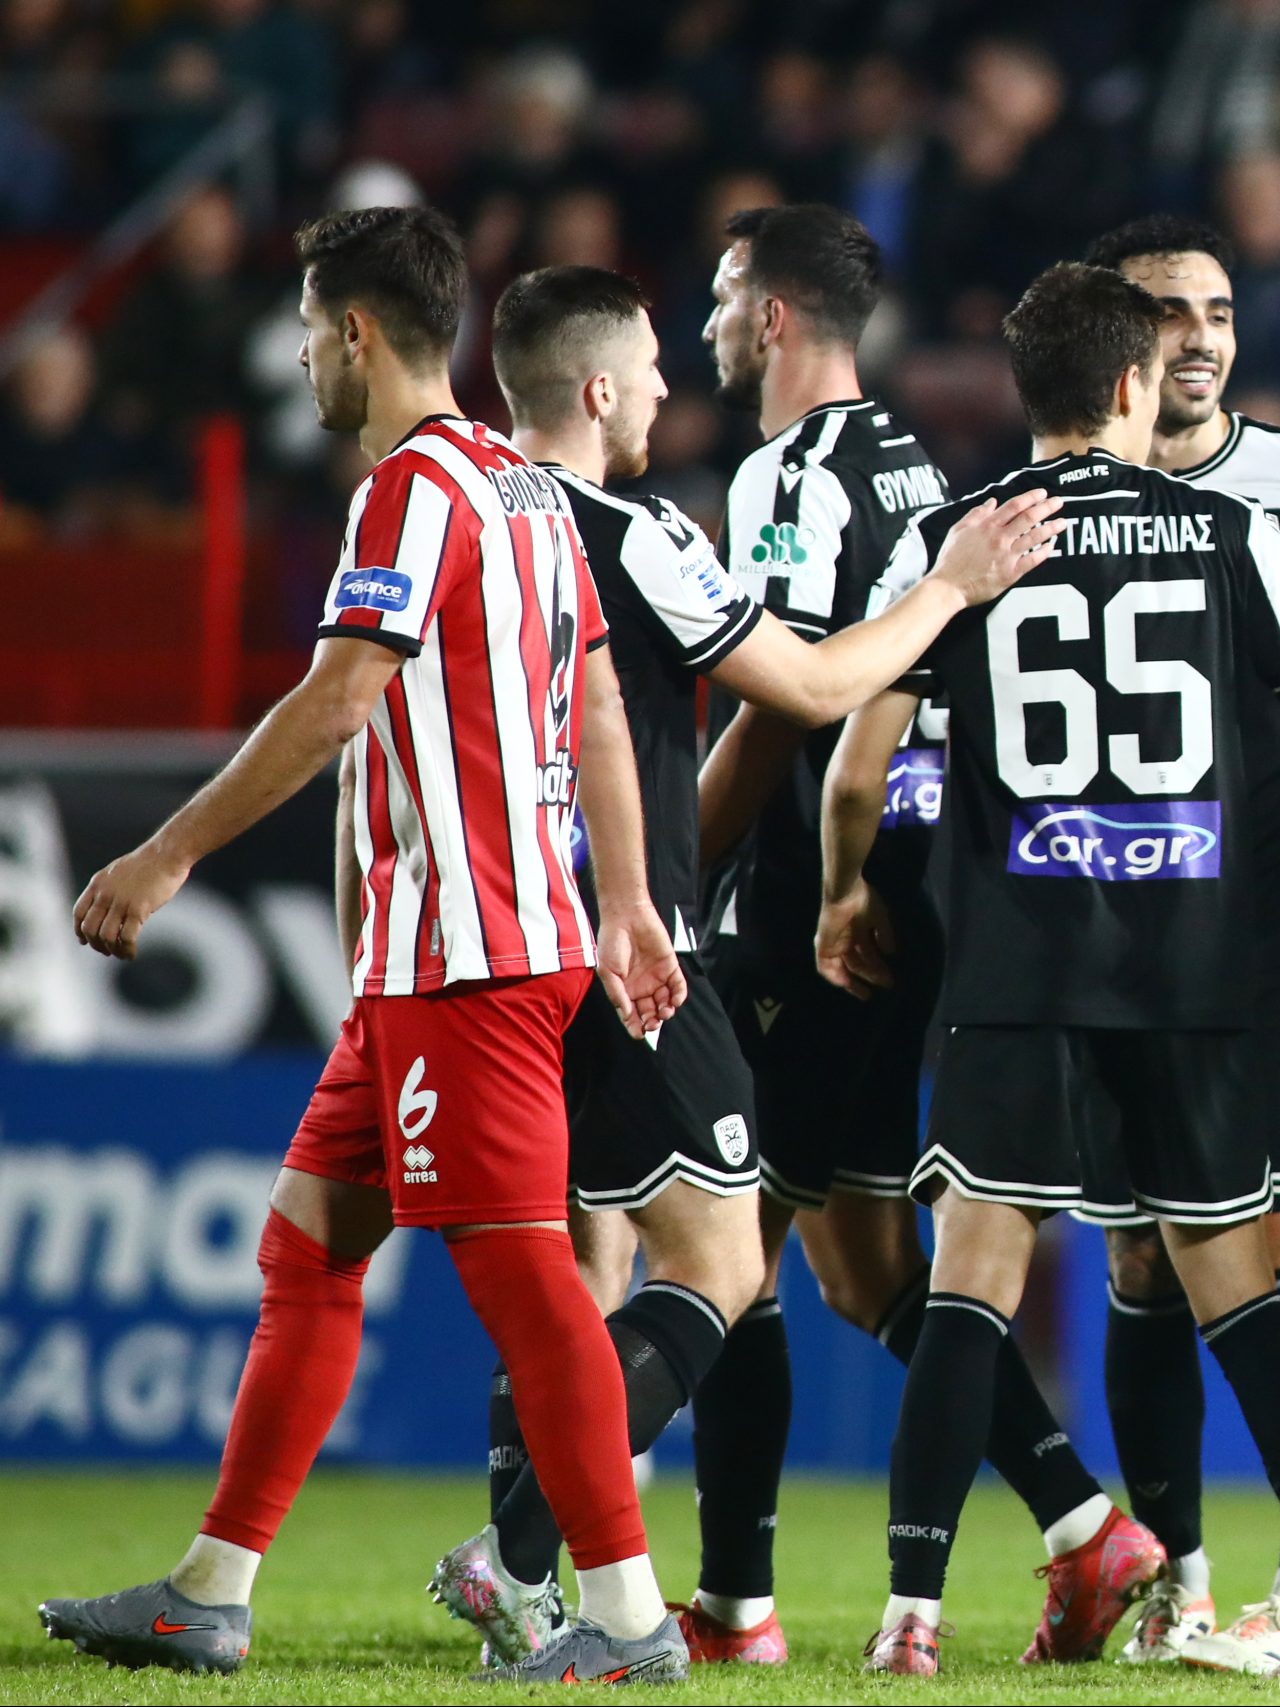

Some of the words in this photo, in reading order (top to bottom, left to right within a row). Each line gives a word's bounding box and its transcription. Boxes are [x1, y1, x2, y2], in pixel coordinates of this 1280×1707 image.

[1058, 467, 1092, 486] PAOK
[1092, 464, 1110, 477] FC
[986, 578, 1214, 799] 65
[397, 1055, 438, 1140] 6
[888, 1524, 931, 1538] PAOK
